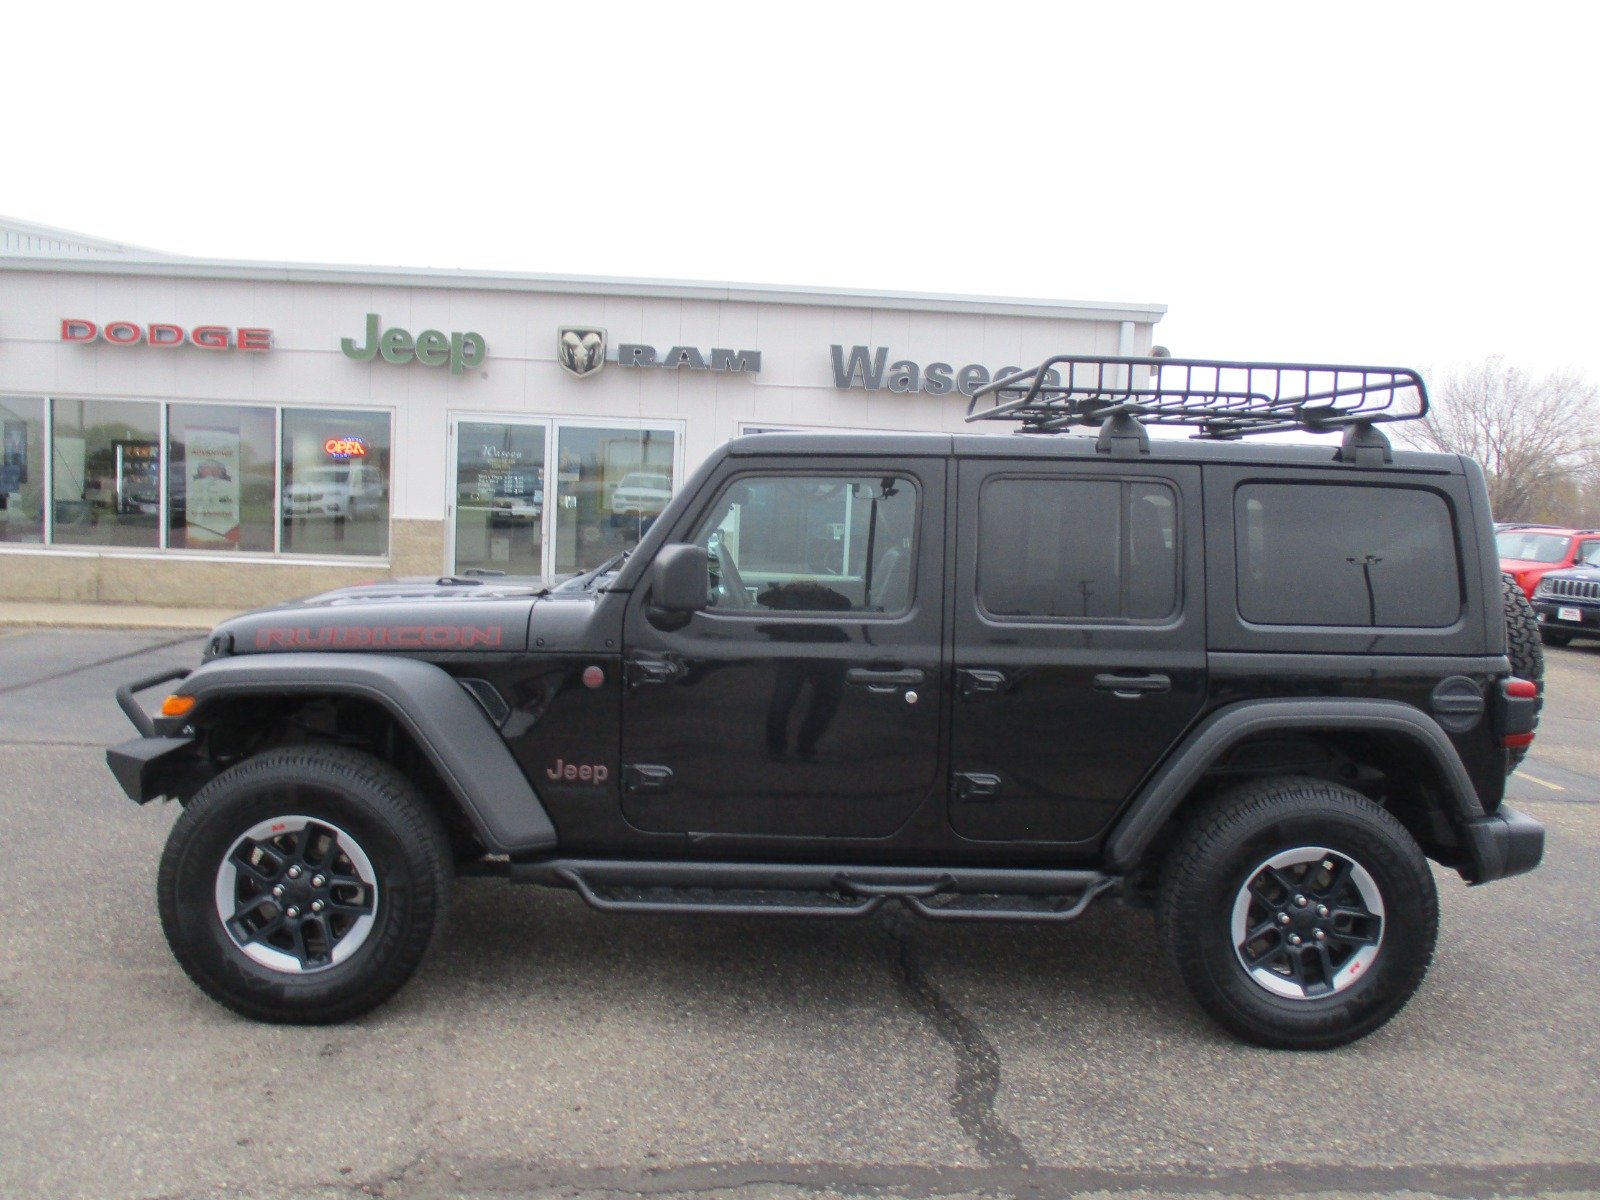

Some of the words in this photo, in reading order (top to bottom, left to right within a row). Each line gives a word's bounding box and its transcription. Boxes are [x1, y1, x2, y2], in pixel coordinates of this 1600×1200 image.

[60, 318, 274, 352] DODGE
[341, 313, 486, 376] Jeep
[617, 343, 762, 373] RAM
[254, 625, 502, 649] RUBICON
[546, 759, 609, 784] Jeep
